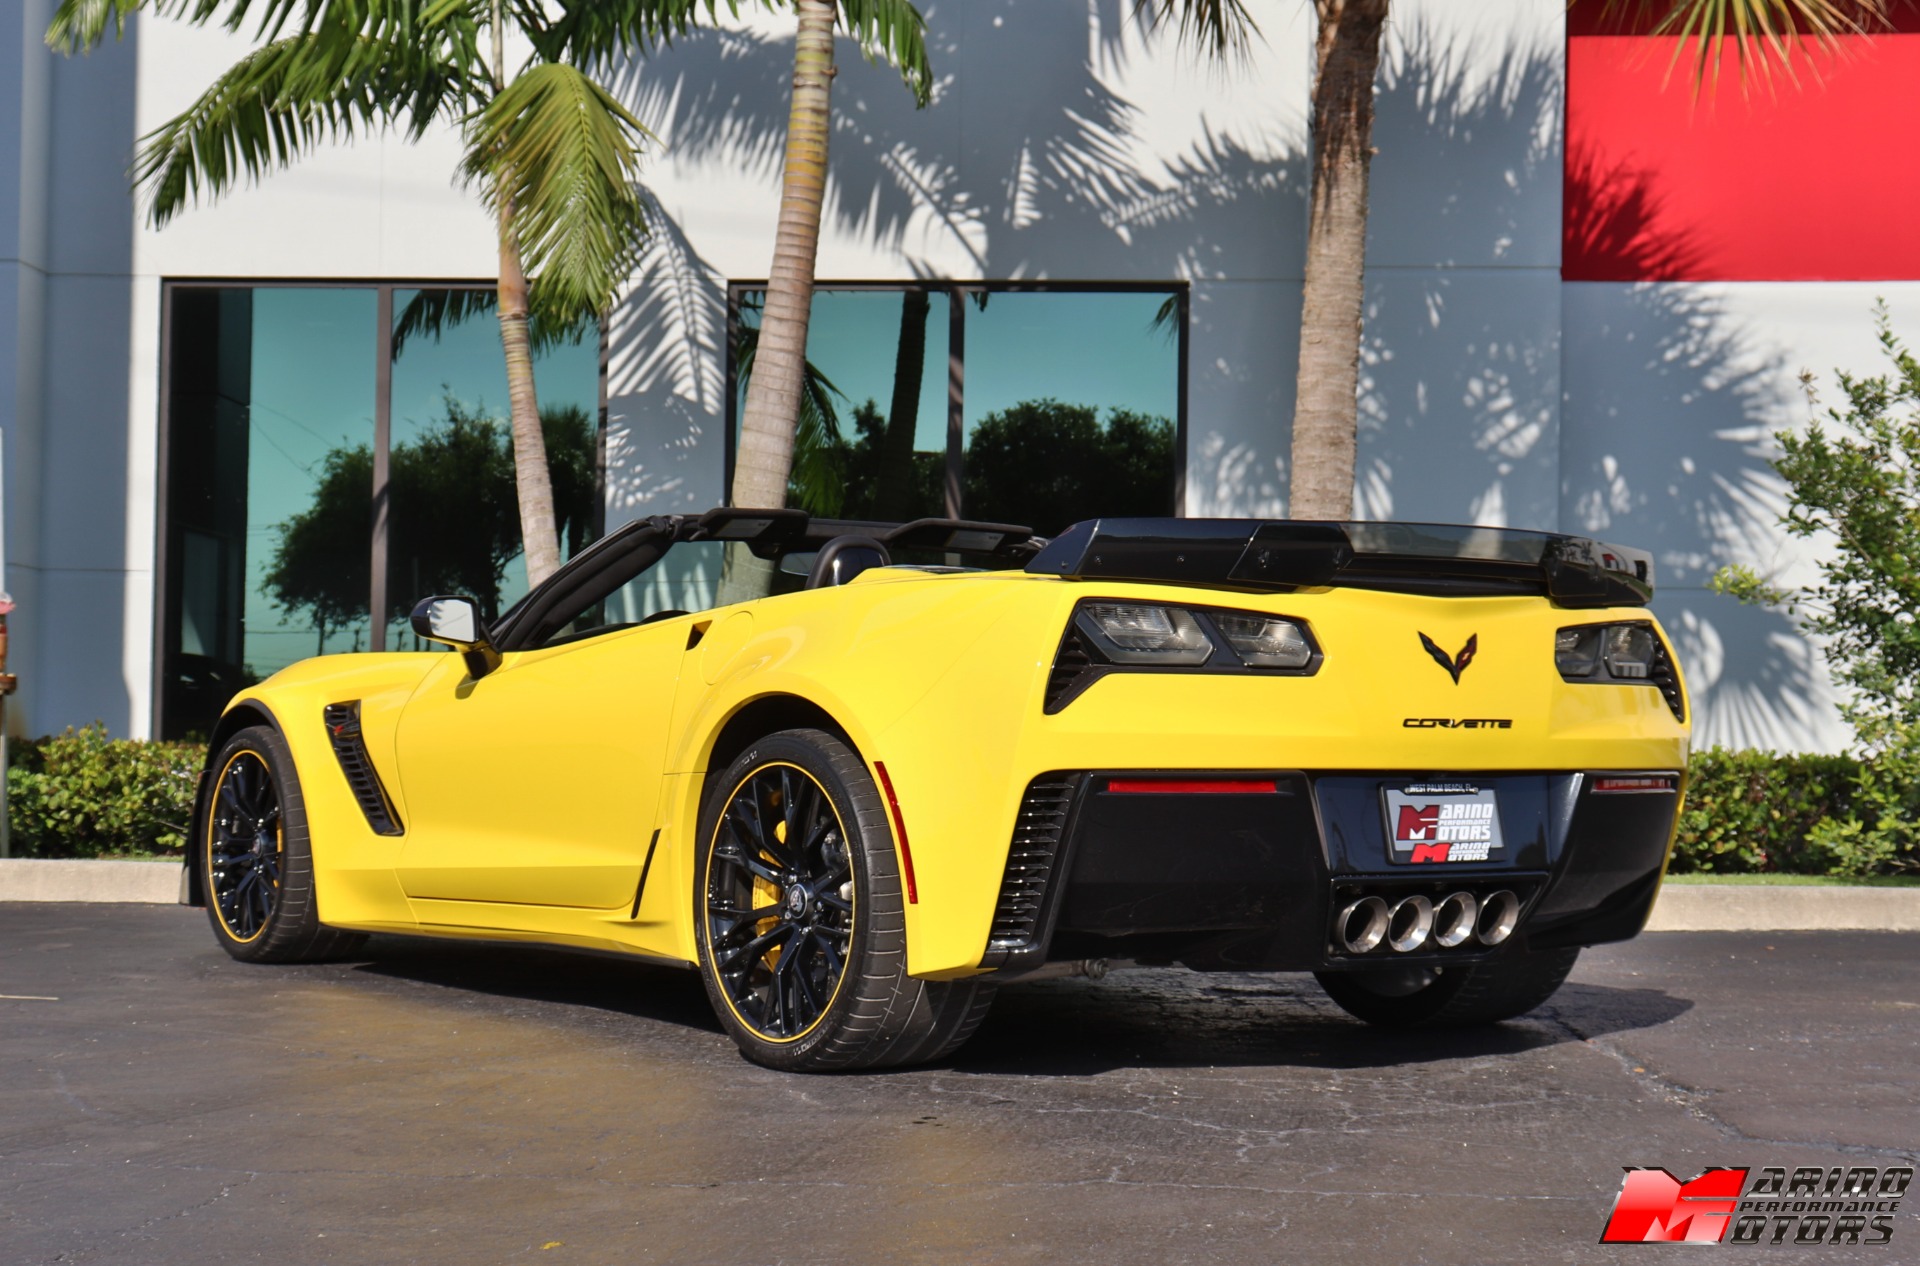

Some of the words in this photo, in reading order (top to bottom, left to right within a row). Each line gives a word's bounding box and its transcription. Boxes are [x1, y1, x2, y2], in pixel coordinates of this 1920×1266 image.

[1402, 718, 1513, 728] CORVETTE
[1410, 784, 1426, 793] WEST
[1427, 783, 1443, 792] PALM
[1438, 818, 1491, 826] PERFORMANCE
